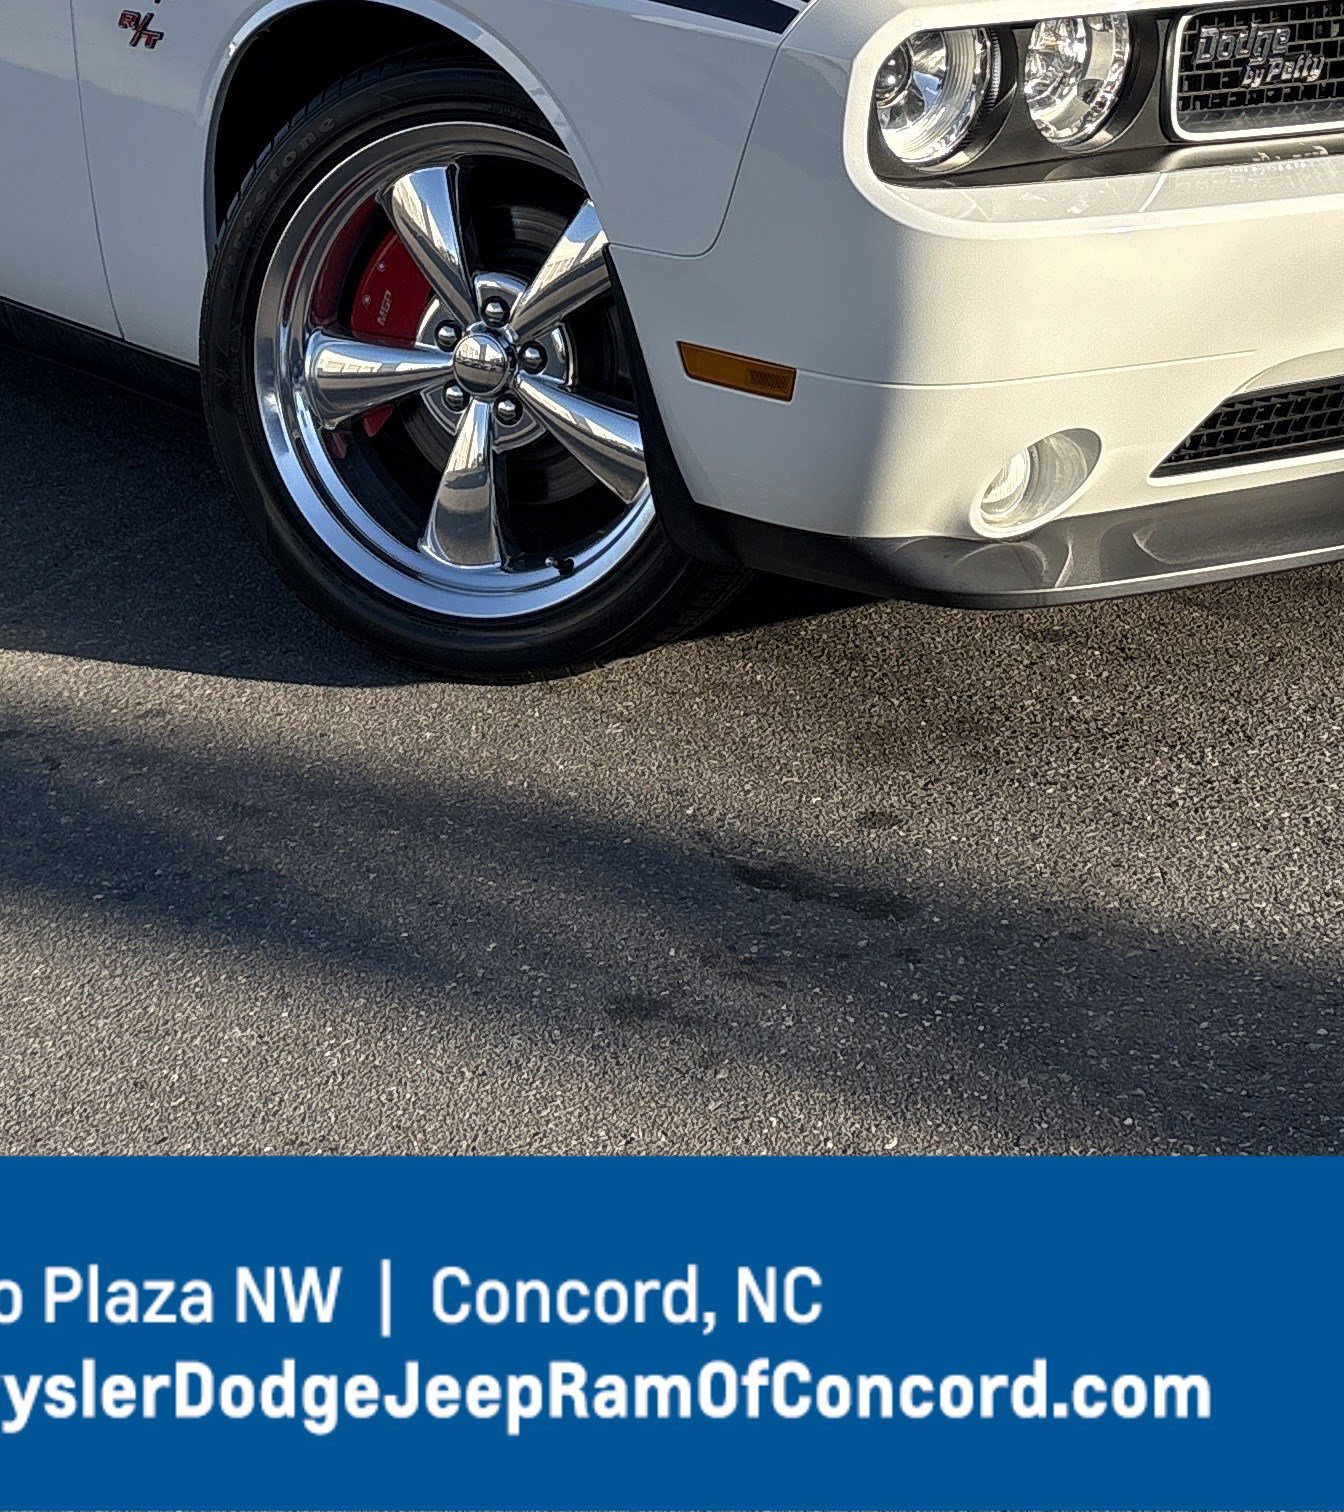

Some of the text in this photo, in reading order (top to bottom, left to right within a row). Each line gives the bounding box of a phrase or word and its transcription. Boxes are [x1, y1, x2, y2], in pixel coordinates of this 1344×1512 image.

[117, 9, 165, 49] R/T
[1194, 24, 1291, 66] Dodge
[376, 289, 393, 326] MGP
